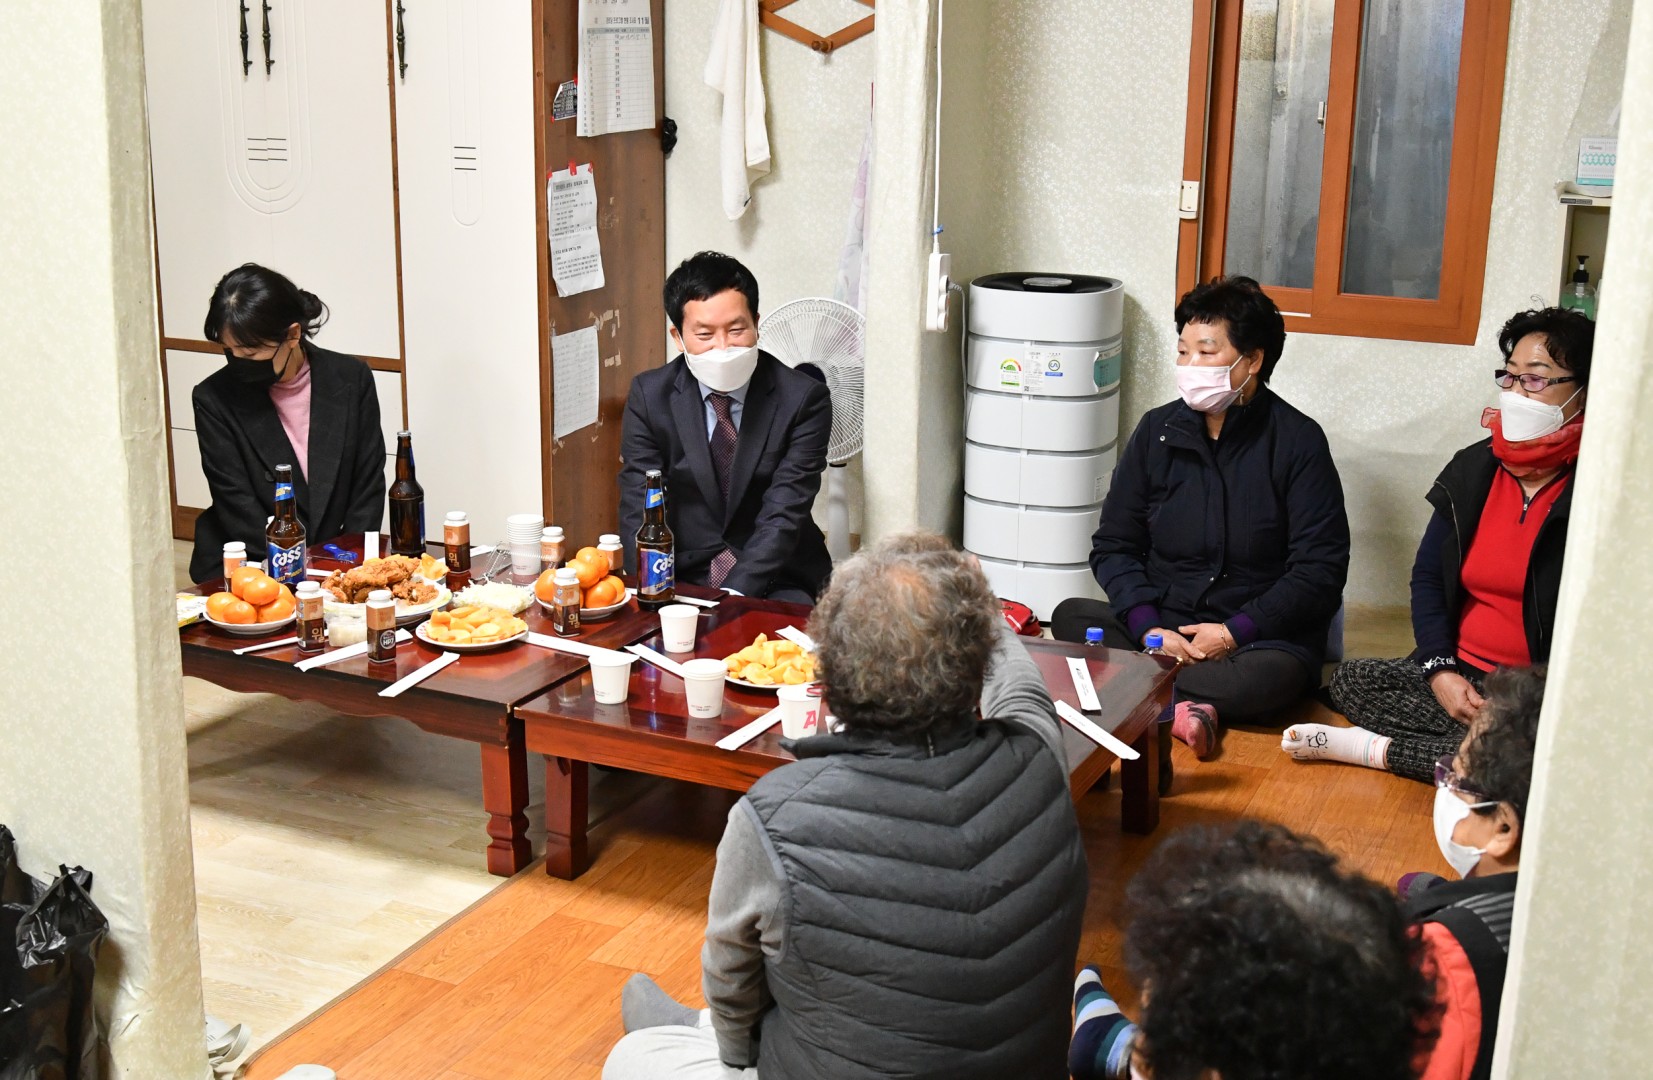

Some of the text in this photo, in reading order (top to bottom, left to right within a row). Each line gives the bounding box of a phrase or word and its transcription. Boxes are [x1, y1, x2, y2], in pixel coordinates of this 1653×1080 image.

[568, 613, 581, 629] 윌
[311, 627, 326, 644] 윌
[383, 637, 395, 646] HP7
